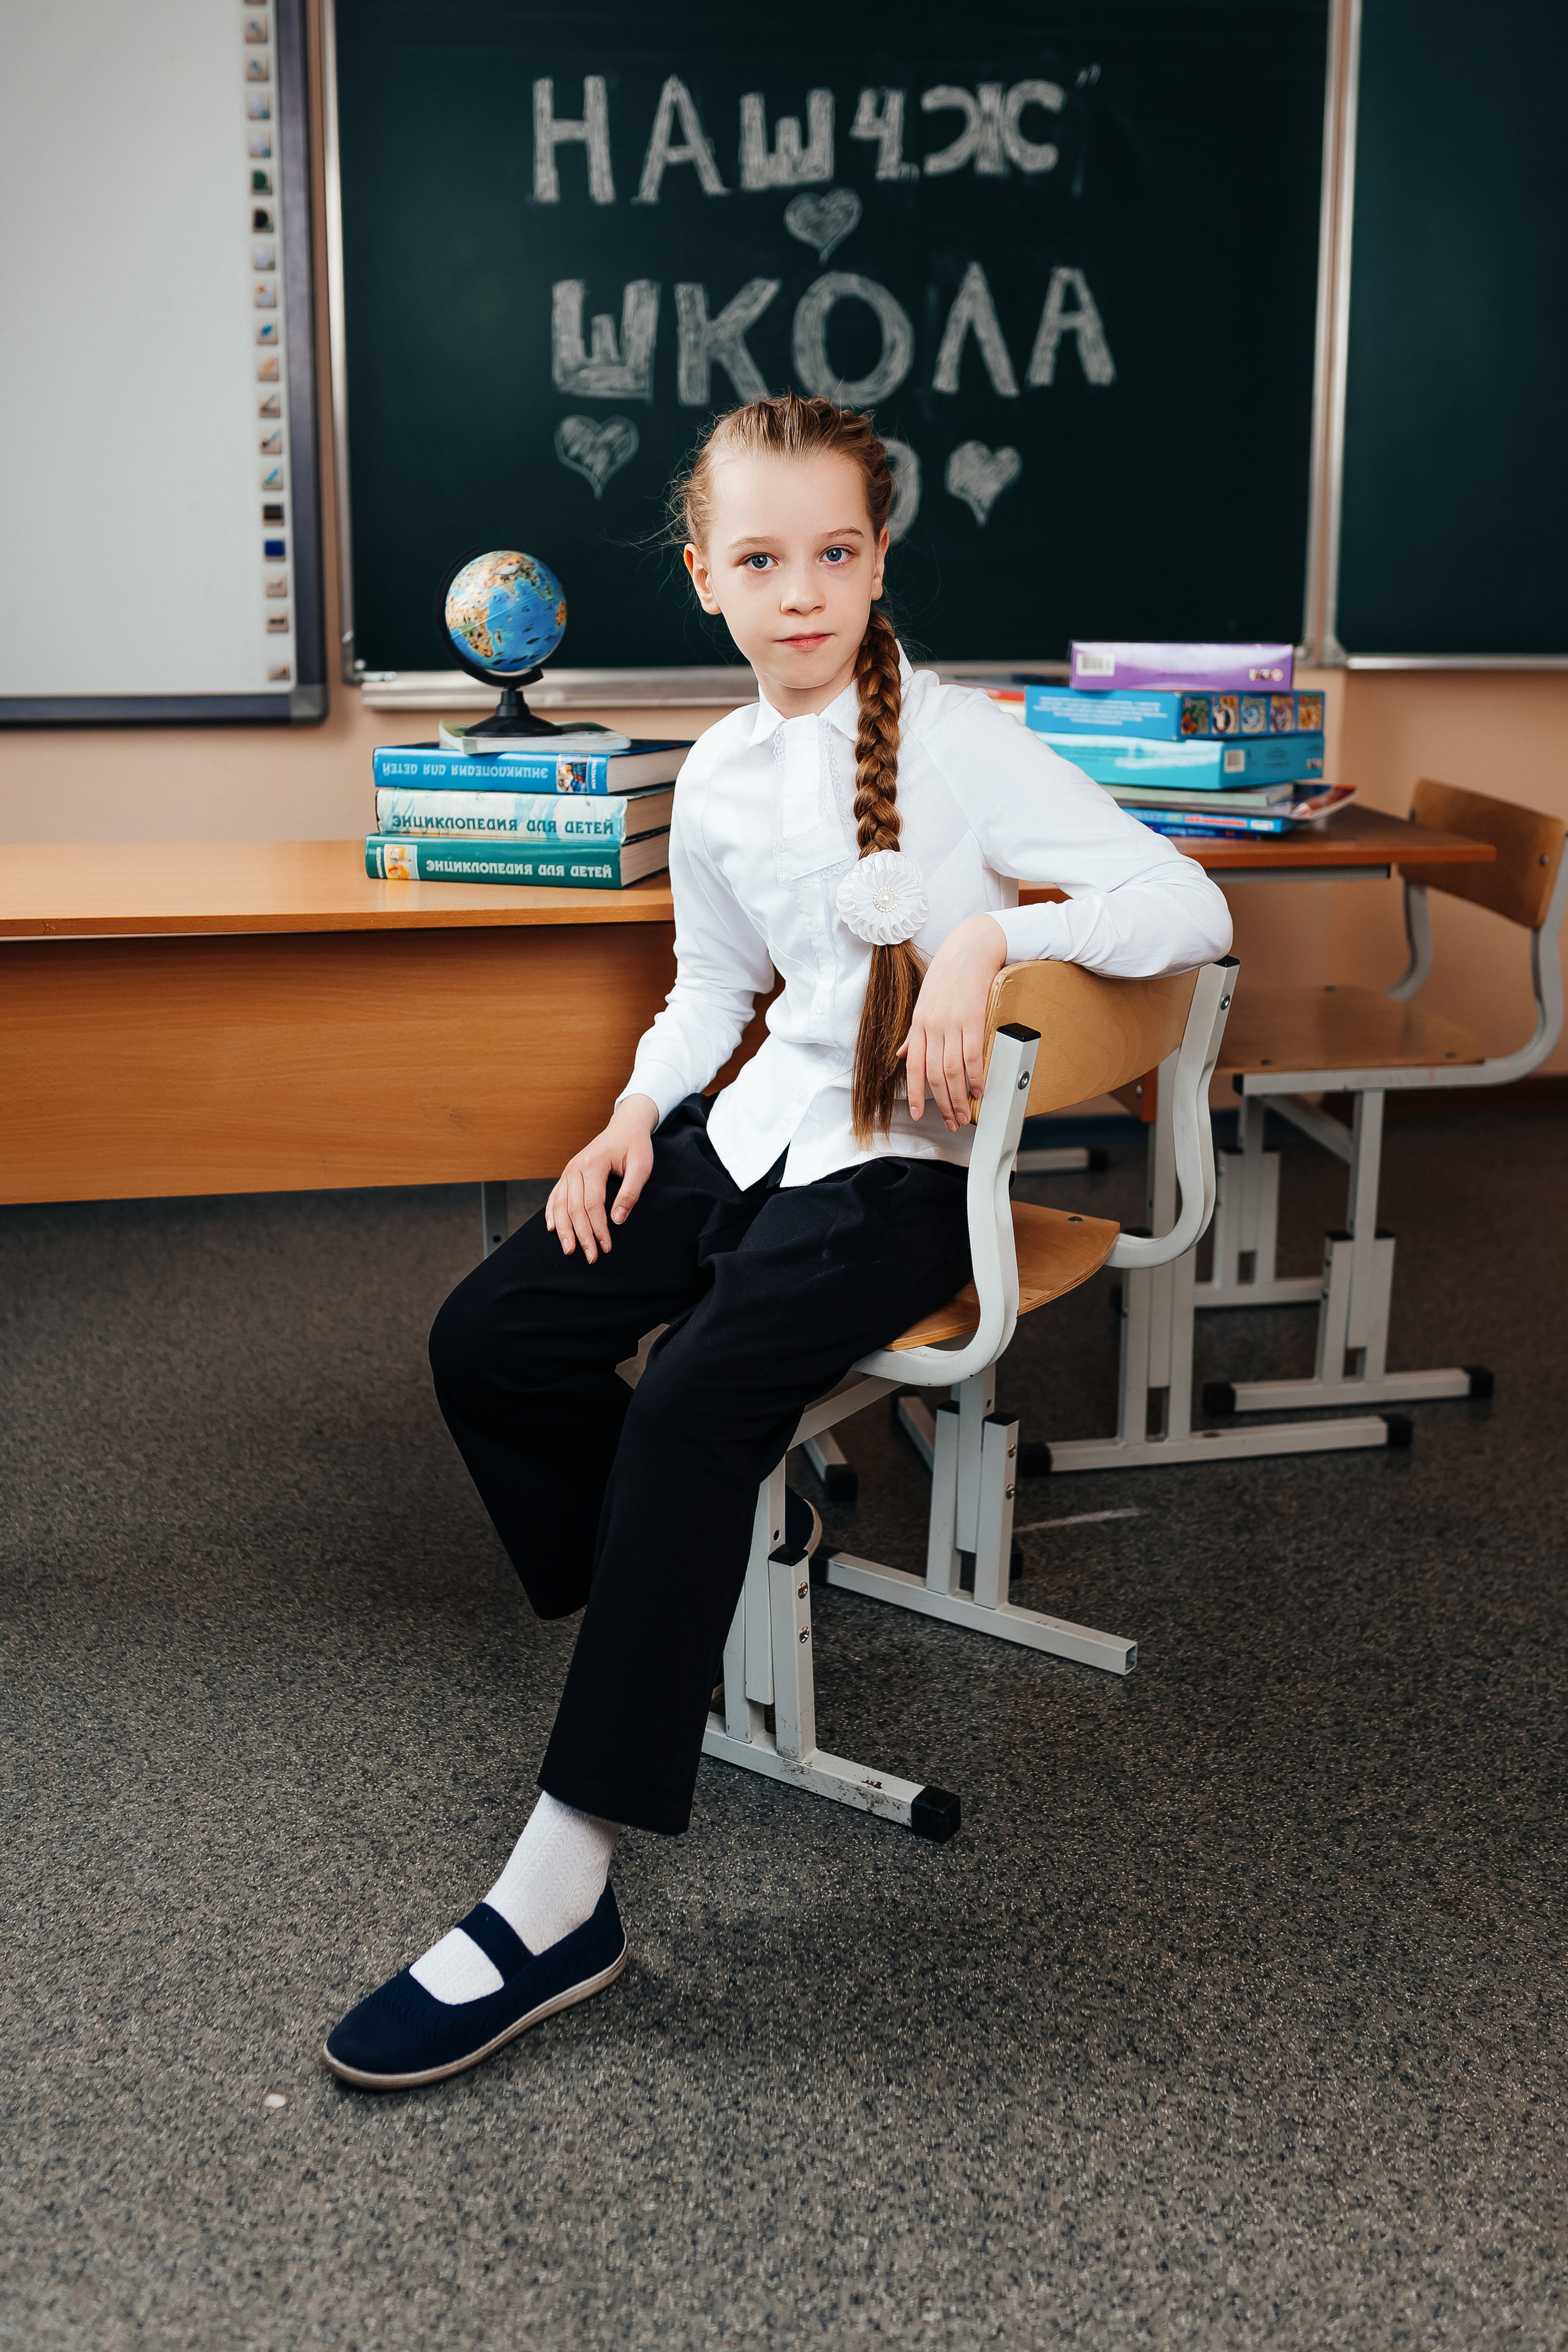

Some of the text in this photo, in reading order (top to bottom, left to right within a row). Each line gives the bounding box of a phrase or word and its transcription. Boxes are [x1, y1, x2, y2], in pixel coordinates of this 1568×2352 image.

[532, 74, 835, 204] НАШ
[551, 261, 1117, 407] ШКОЛА
[382, 763, 549, 779] ЭНЦИКЛОПЕДИЯ ДЛЯ ДЕТЕЙ
[391, 815, 614, 835] ЭНЦИКЛОПЕДИЯ ДЛЯ ДЕТЕЙ
[425, 859, 612, 878] ЭНЦИКЛОПЕДИЯ ДЛЯ ДЕТЕЙ
